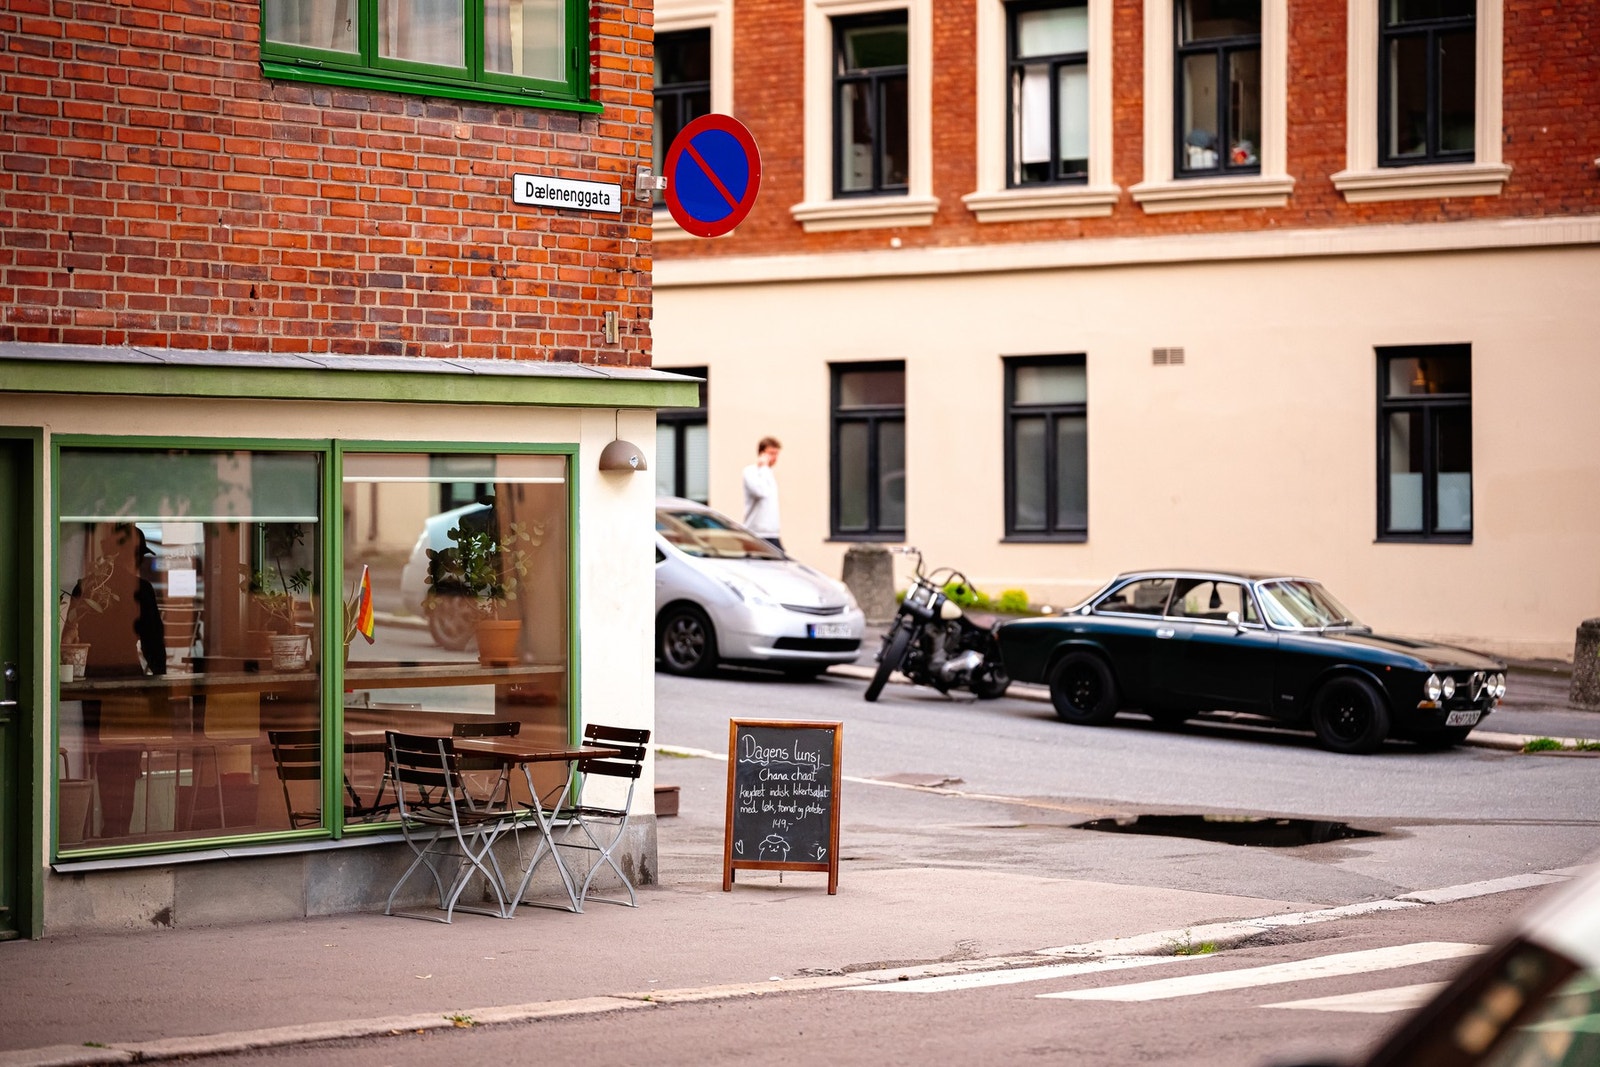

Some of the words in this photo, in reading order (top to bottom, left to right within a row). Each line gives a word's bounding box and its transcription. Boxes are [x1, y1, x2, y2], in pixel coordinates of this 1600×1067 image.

[526, 182, 610, 207] Dælenenggata
[742, 734, 789, 766] Dagens
[794, 739, 822, 770] lunsj
[759, 768, 789, 781] Chana
[791, 764, 817, 782] chaat
[740, 784, 765, 805] krydret
[769, 785, 789, 797] indisk
[740, 800, 758, 813] med
[762, 800, 776, 814] løk,
[778, 800, 797, 813] tomat
[796, 808, 803, 820] og
